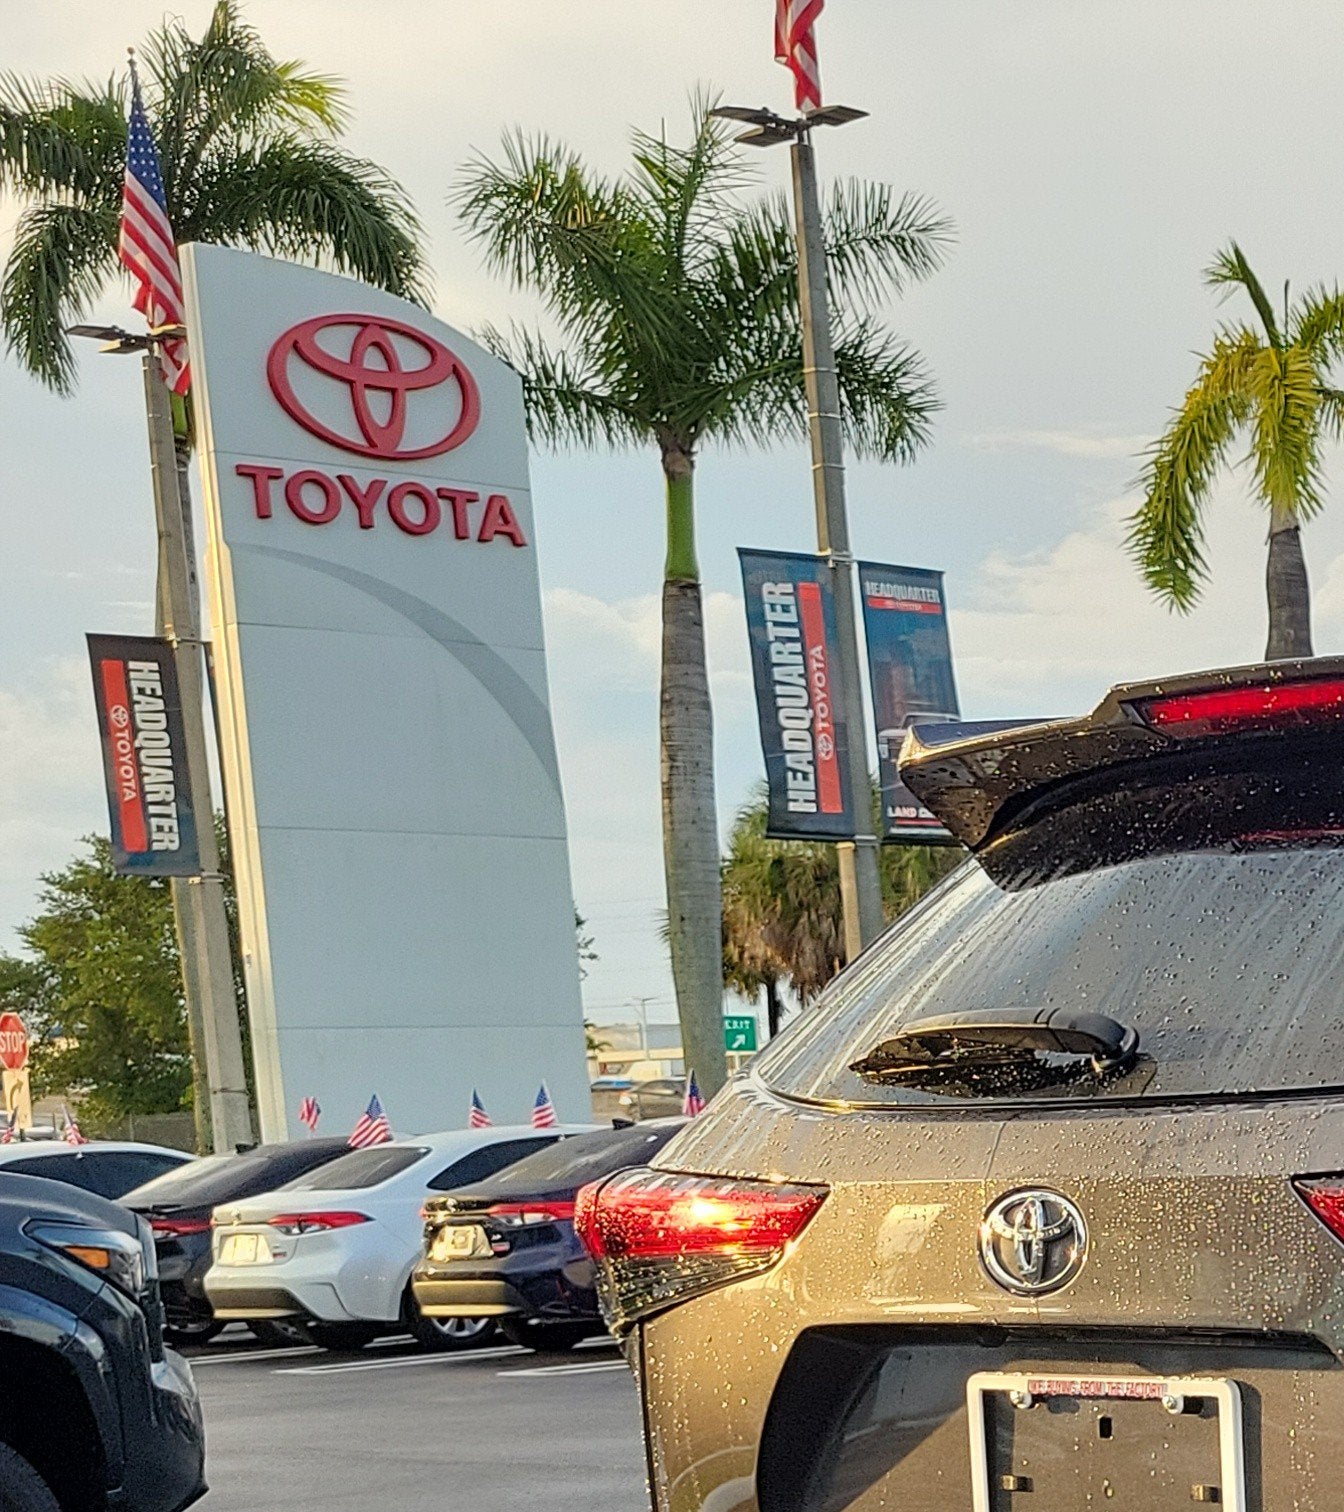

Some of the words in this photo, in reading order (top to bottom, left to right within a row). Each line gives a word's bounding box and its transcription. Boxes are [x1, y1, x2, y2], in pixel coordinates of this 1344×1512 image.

[235, 464, 527, 547] TOYOTA
[762, 581, 817, 813] HEADQUARTER
[809, 645, 830, 729] TOYOTA
[114, 729, 137, 801] TOYOTA
[128, 660, 181, 851] HEADQUARTER
[887, 806, 917, 818] LAND
[0, 1030, 26, 1053] STOP
[725, 1019, 750, 1030] EXIT
